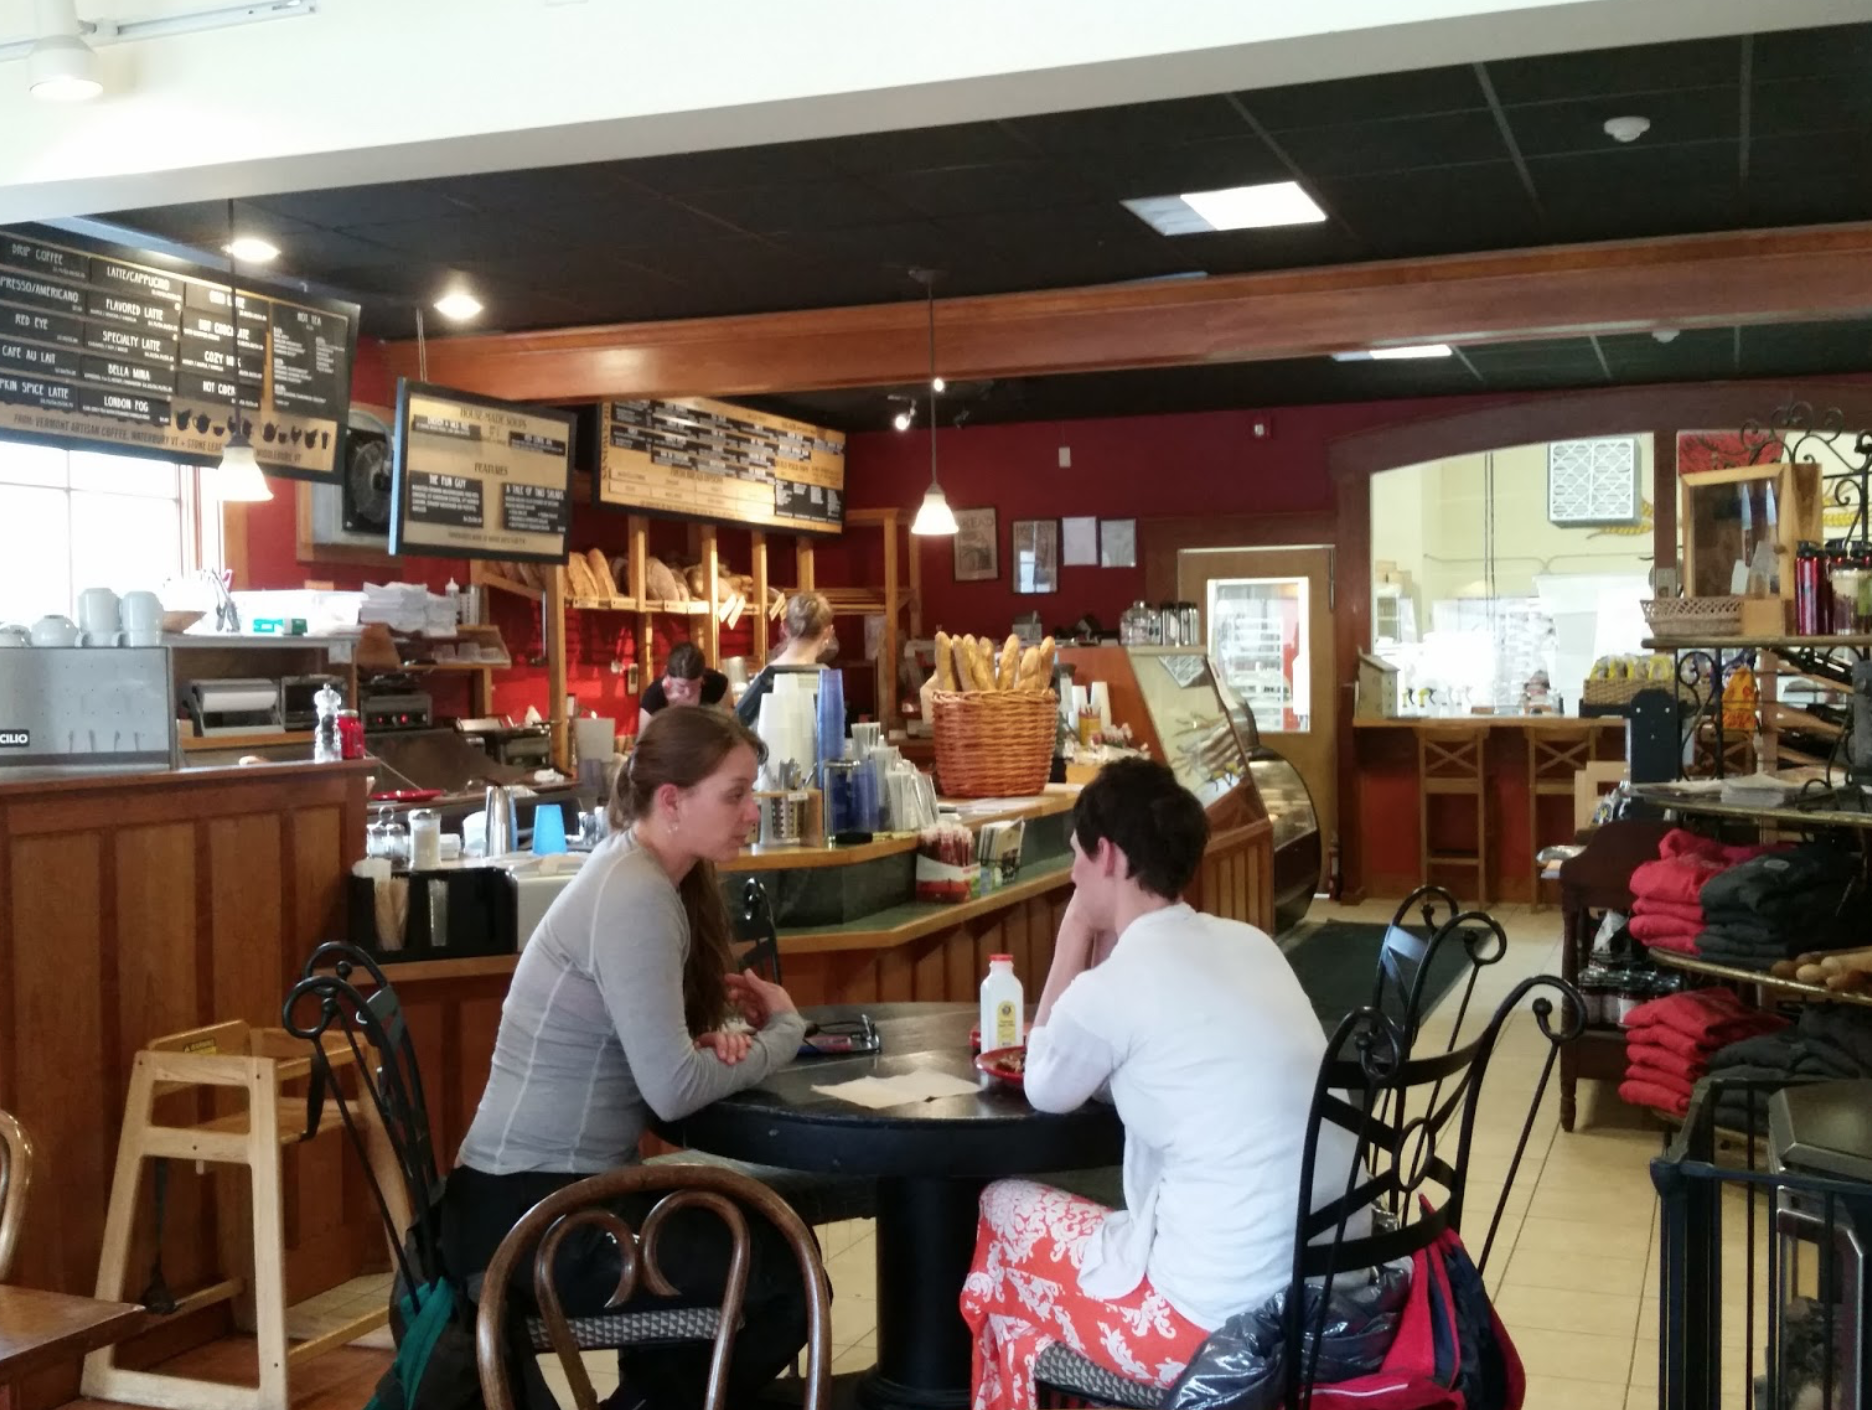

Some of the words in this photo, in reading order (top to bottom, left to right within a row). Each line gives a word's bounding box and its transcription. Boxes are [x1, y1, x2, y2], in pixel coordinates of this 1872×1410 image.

[12, 243, 31, 257] DRIP
[35, 249, 63, 265] COFFEE
[106, 298, 141, 316] FLAVORED
[144, 306, 164, 321] LATTE
[15, 313, 31, 326] RED
[34, 316, 48, 330] EYE
[102, 330, 139, 347] SPECIALTY
[141, 338, 161, 352] LATTE
[26, 349, 37, 361] AU
[40, 352, 56, 364] LAIT
[204, 350, 224, 365] COZY
[107, 363, 129, 377] BELLA
[22, 382, 44, 395] SPICE
[48, 386, 69, 399] LATTE
[202, 380, 215, 393] HOT
[103, 395, 132, 410] LONDON
[134, 400, 149, 412] FOG
[0, 733, 28, 744] CILIO
